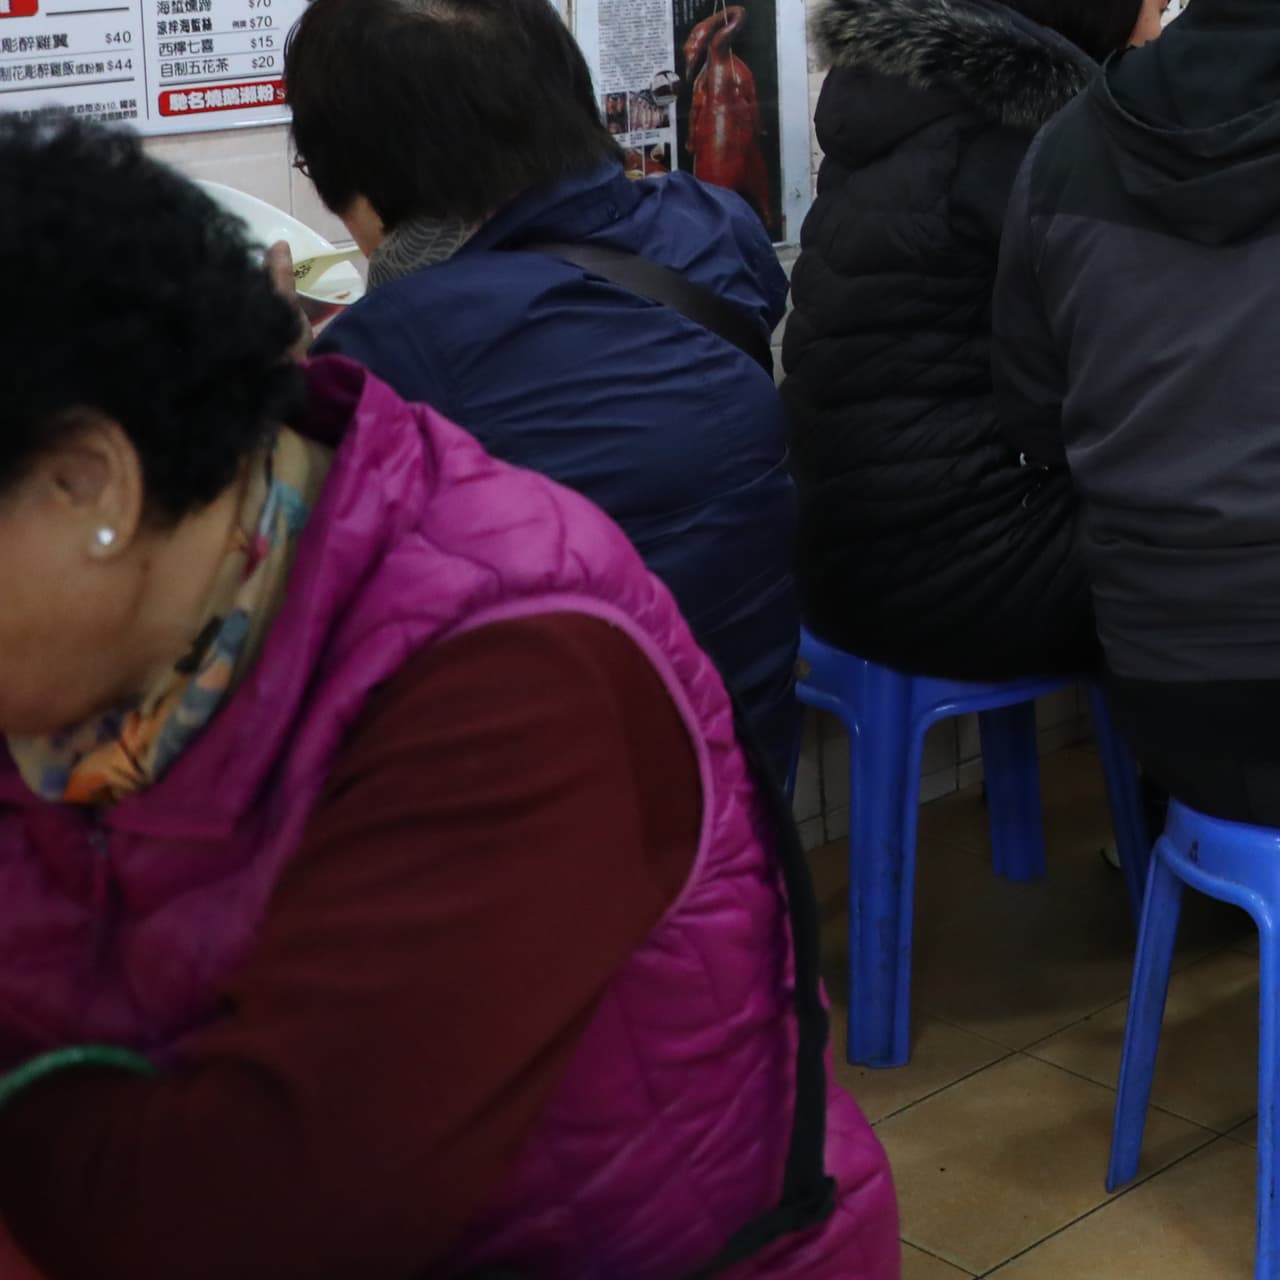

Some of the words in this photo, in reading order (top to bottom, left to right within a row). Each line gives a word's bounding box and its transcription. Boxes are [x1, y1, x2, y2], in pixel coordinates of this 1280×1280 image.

[250, 16, 272, 29] $70
[105, 31, 132, 45] $40
[251, 36, 273, 49] $15
[107, 59, 133, 71] $44
[252, 56, 274, 69] $20
